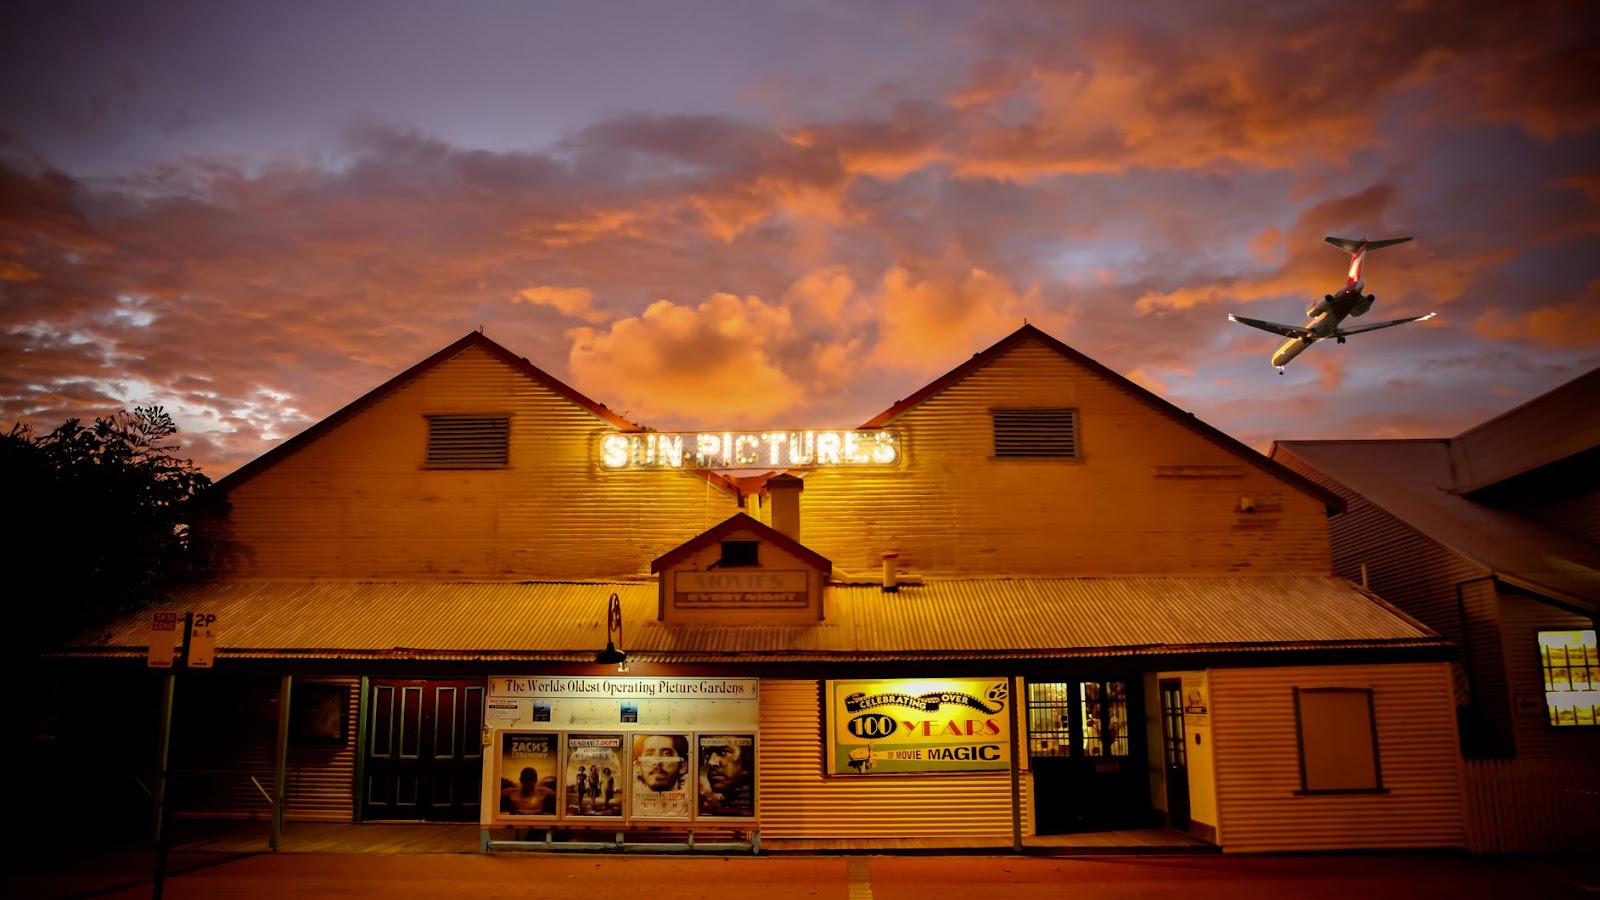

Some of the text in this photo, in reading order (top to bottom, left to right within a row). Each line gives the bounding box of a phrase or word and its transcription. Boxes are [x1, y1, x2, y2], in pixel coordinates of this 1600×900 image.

[603, 431, 897, 468] SUN PICTURES
[695, 573, 785, 587] MOVIES
[686, 592, 798, 602] EVERY NIGHT
[195, 614, 216, 627] 2P
[505, 679, 745, 696] The Worlds Oldest Operating Picture Gardens
[859, 693, 969, 710] CELEBRATING OVER
[852, 716, 1001, 738] 100 YEARS
[888, 744, 1001, 762] OF MOVIE MAGIC
